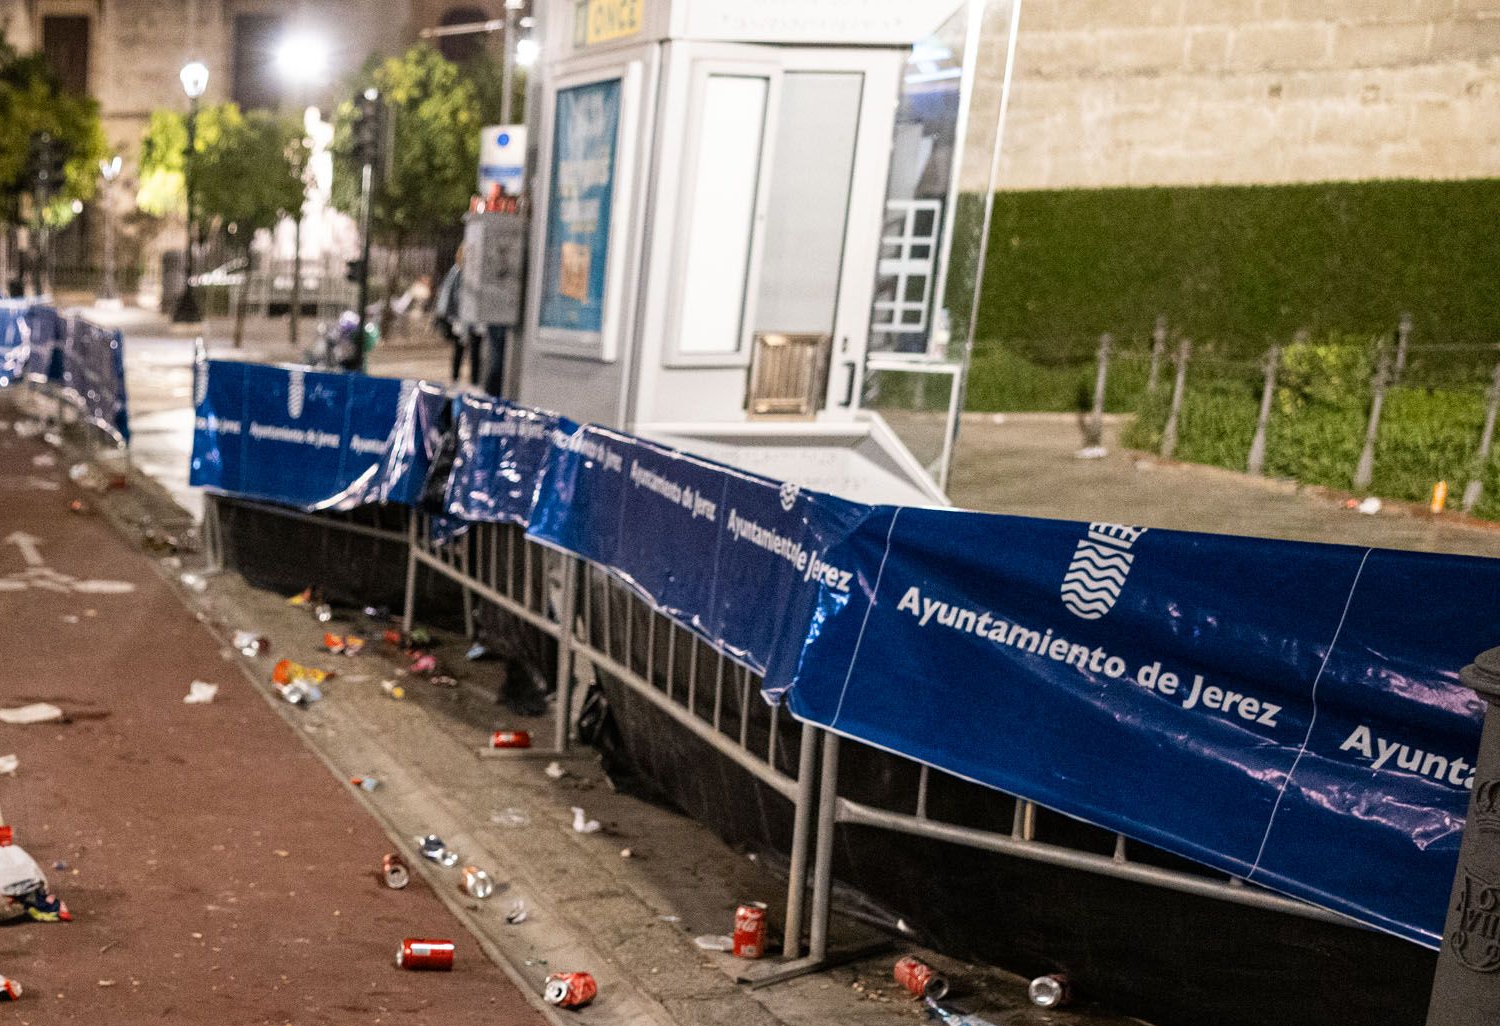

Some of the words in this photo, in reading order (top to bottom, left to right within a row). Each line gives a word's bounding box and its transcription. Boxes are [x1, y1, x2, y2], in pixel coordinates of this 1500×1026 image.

[630, 459, 681, 505] Ayuntamiento
[682, 486, 693, 510] de
[692, 489, 716, 521] Jerez
[804, 550, 853, 592] Jerez
[897, 587, 1126, 678] Ayuntamiento
[1136, 662, 1179, 695] de
[1183, 674, 1283, 727] Jerez
